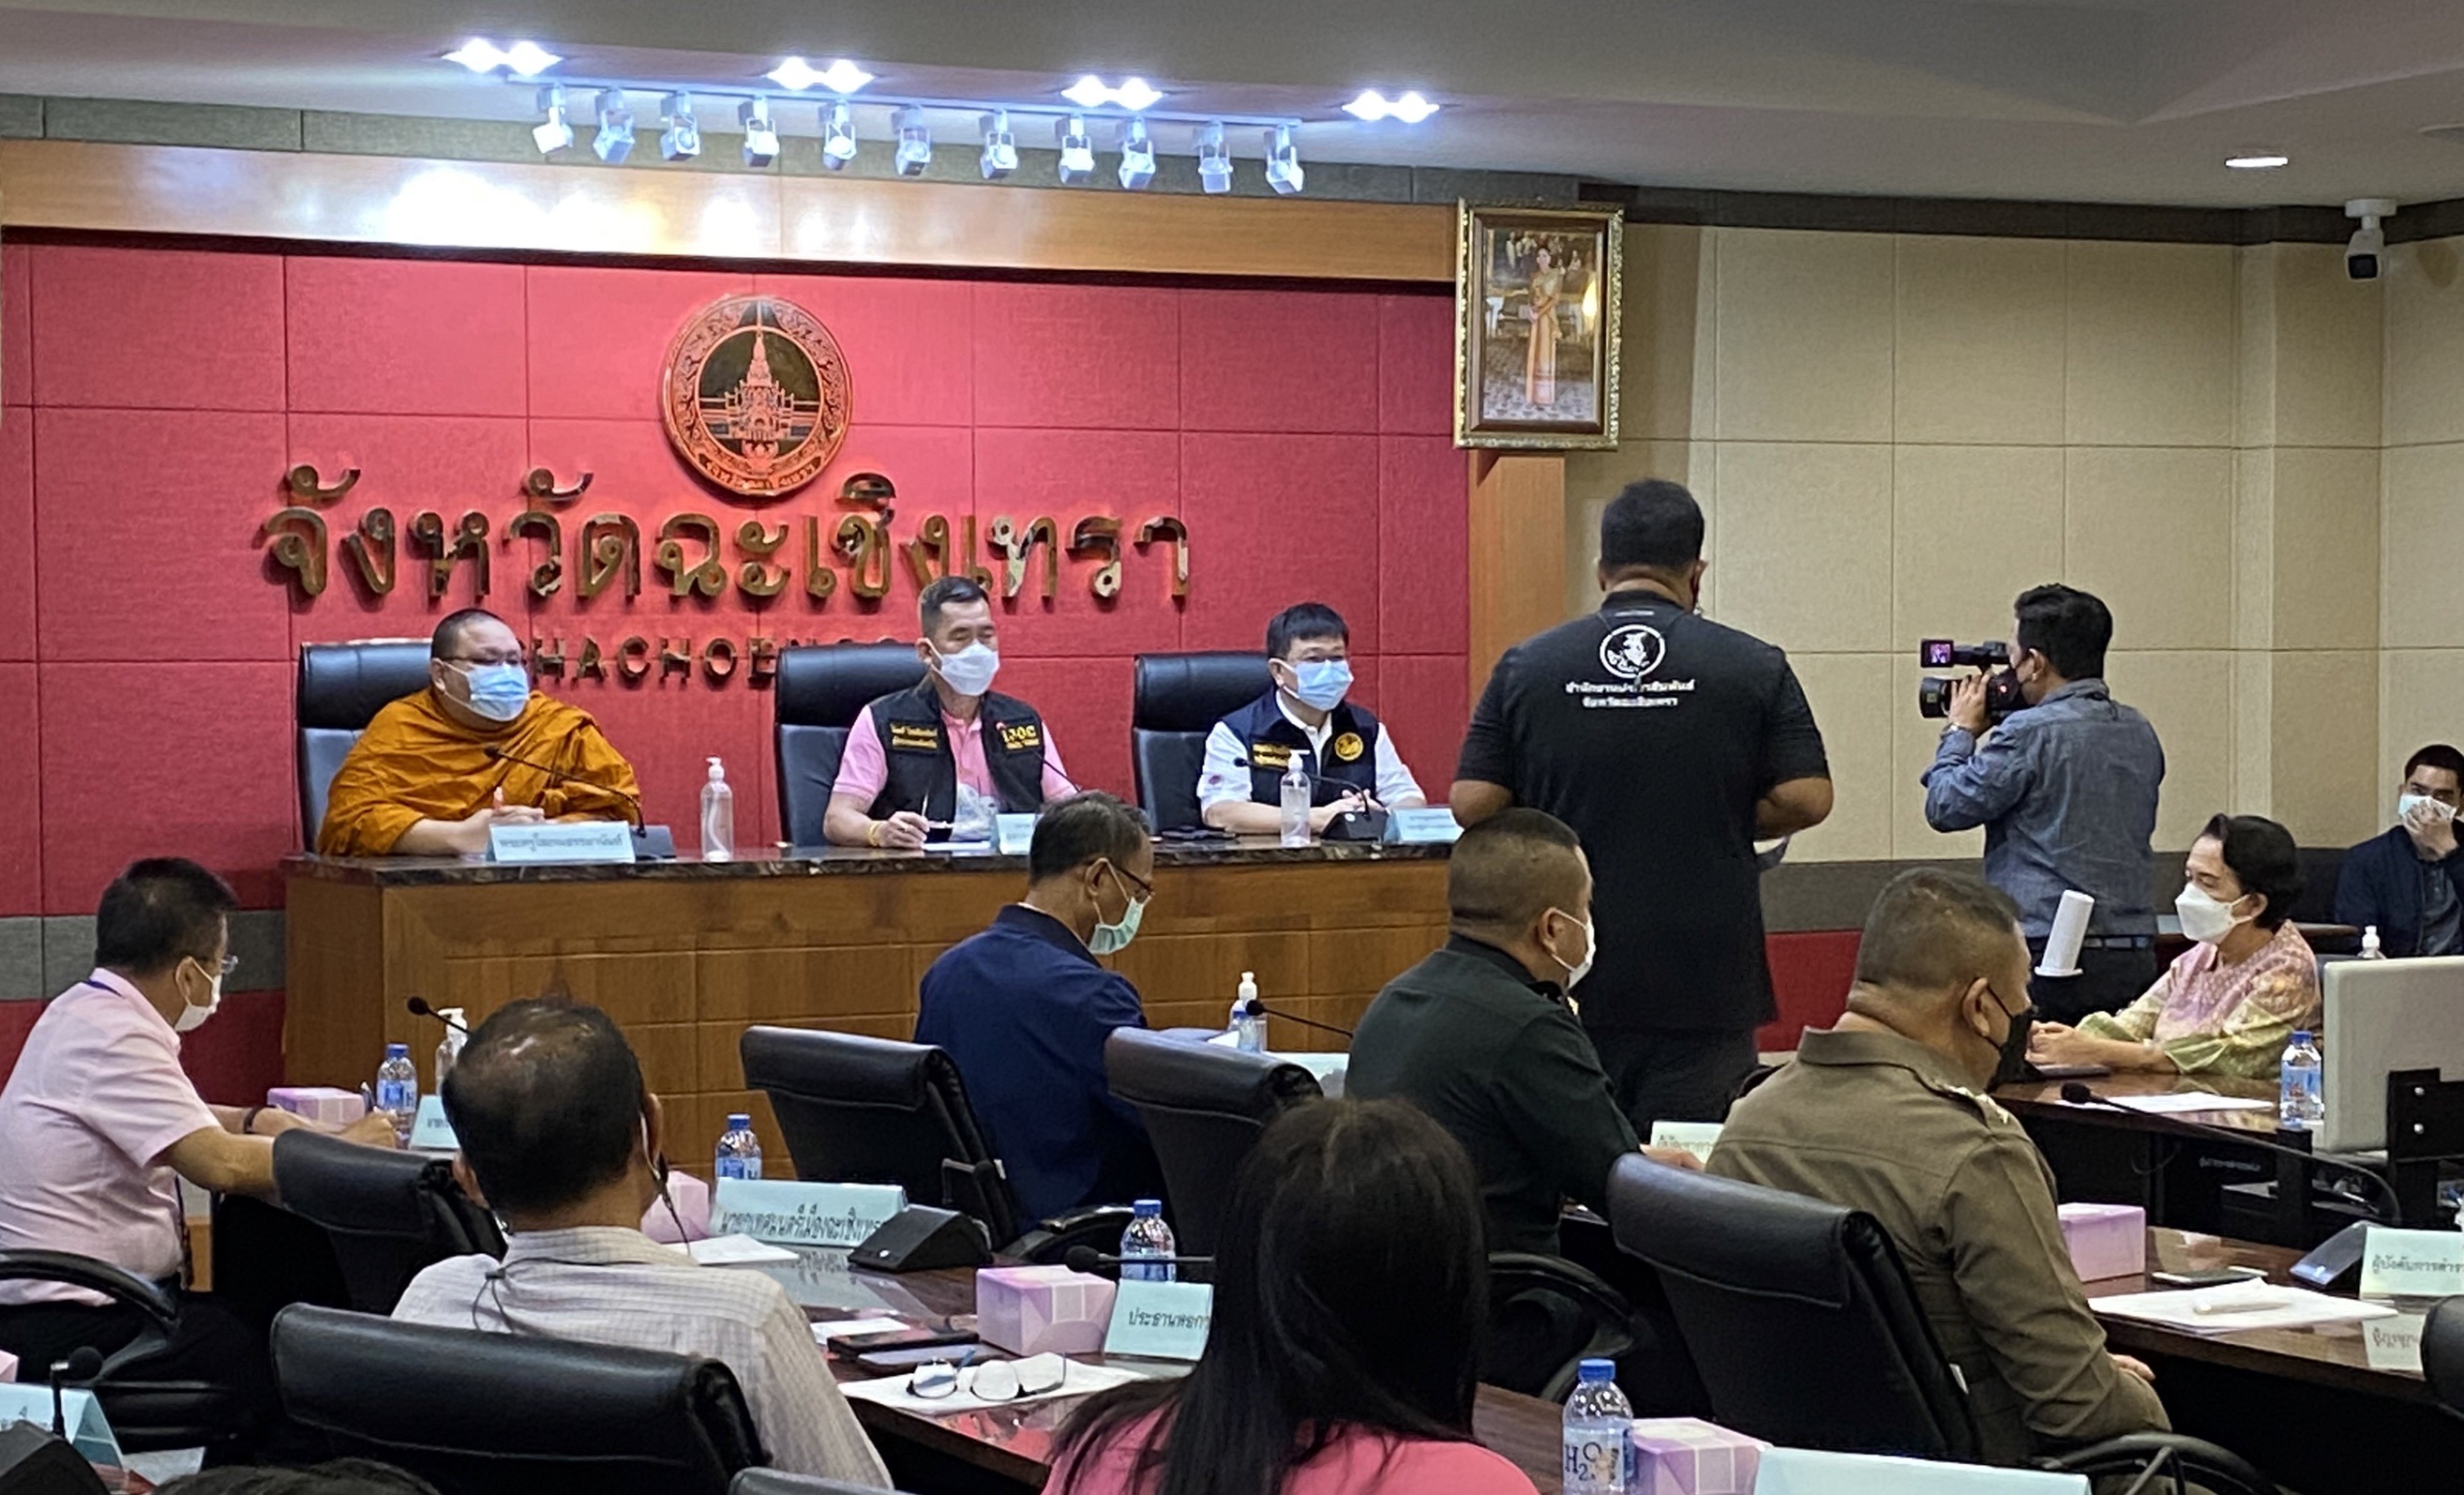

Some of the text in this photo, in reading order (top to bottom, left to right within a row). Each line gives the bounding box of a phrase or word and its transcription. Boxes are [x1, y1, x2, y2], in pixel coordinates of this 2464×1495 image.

[259, 464, 1188, 598] จังหวัดฉะเชิงเทรา
